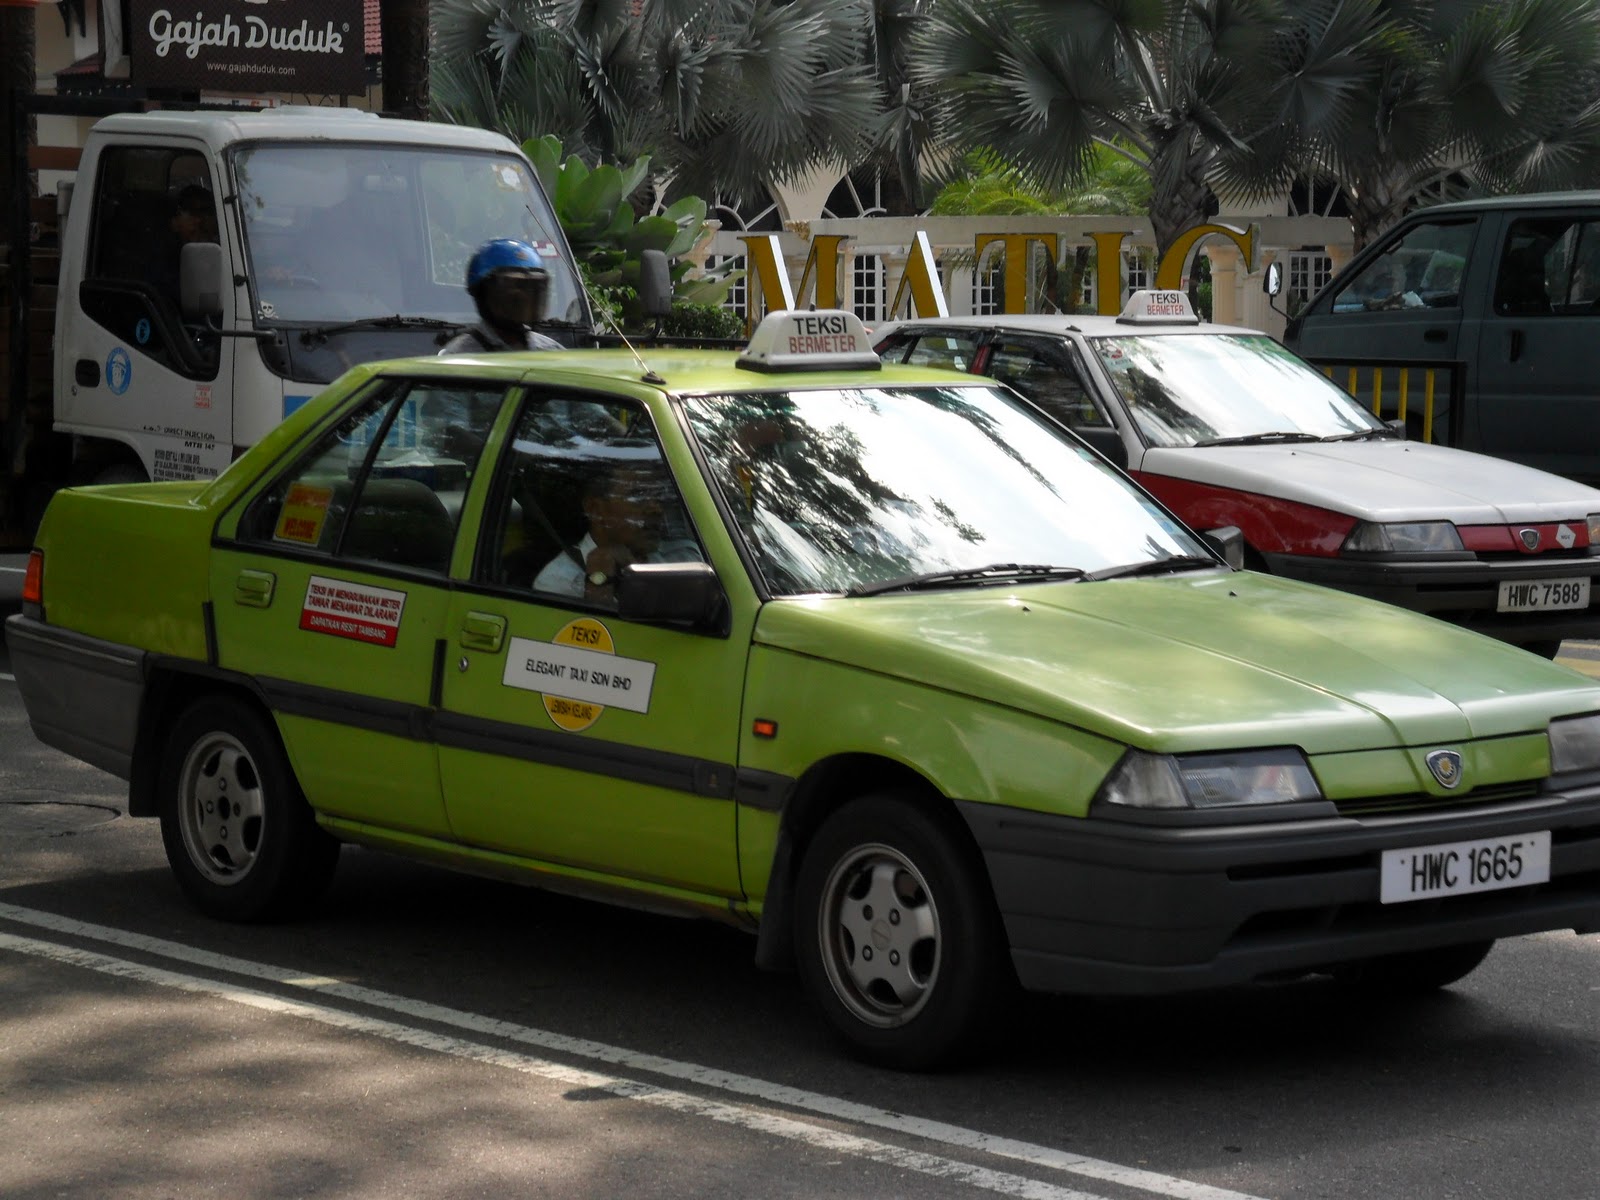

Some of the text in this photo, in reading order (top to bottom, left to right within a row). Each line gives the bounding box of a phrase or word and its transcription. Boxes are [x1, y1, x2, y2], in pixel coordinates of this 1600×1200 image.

[149, 9, 343, 59] Gajah Duduk
[206, 61, 296, 75] www.gajahduduk.com
[1150, 293, 1180, 304] TEKSI
[1147, 304, 1185, 316] BERMETER
[793, 316, 848, 335] TEKSI
[788, 335, 857, 354] BERMETER
[311, 584, 326, 596] TEKSI
[1508, 583, 1581, 607] HWC 7588
[363, 606, 398, 622] DILARANG
[571, 626, 601, 645] TEKSI
[525, 658, 632, 691] ELEGANT TAXI SDN BHD
[1411, 843, 1524, 893] HWC 1665
